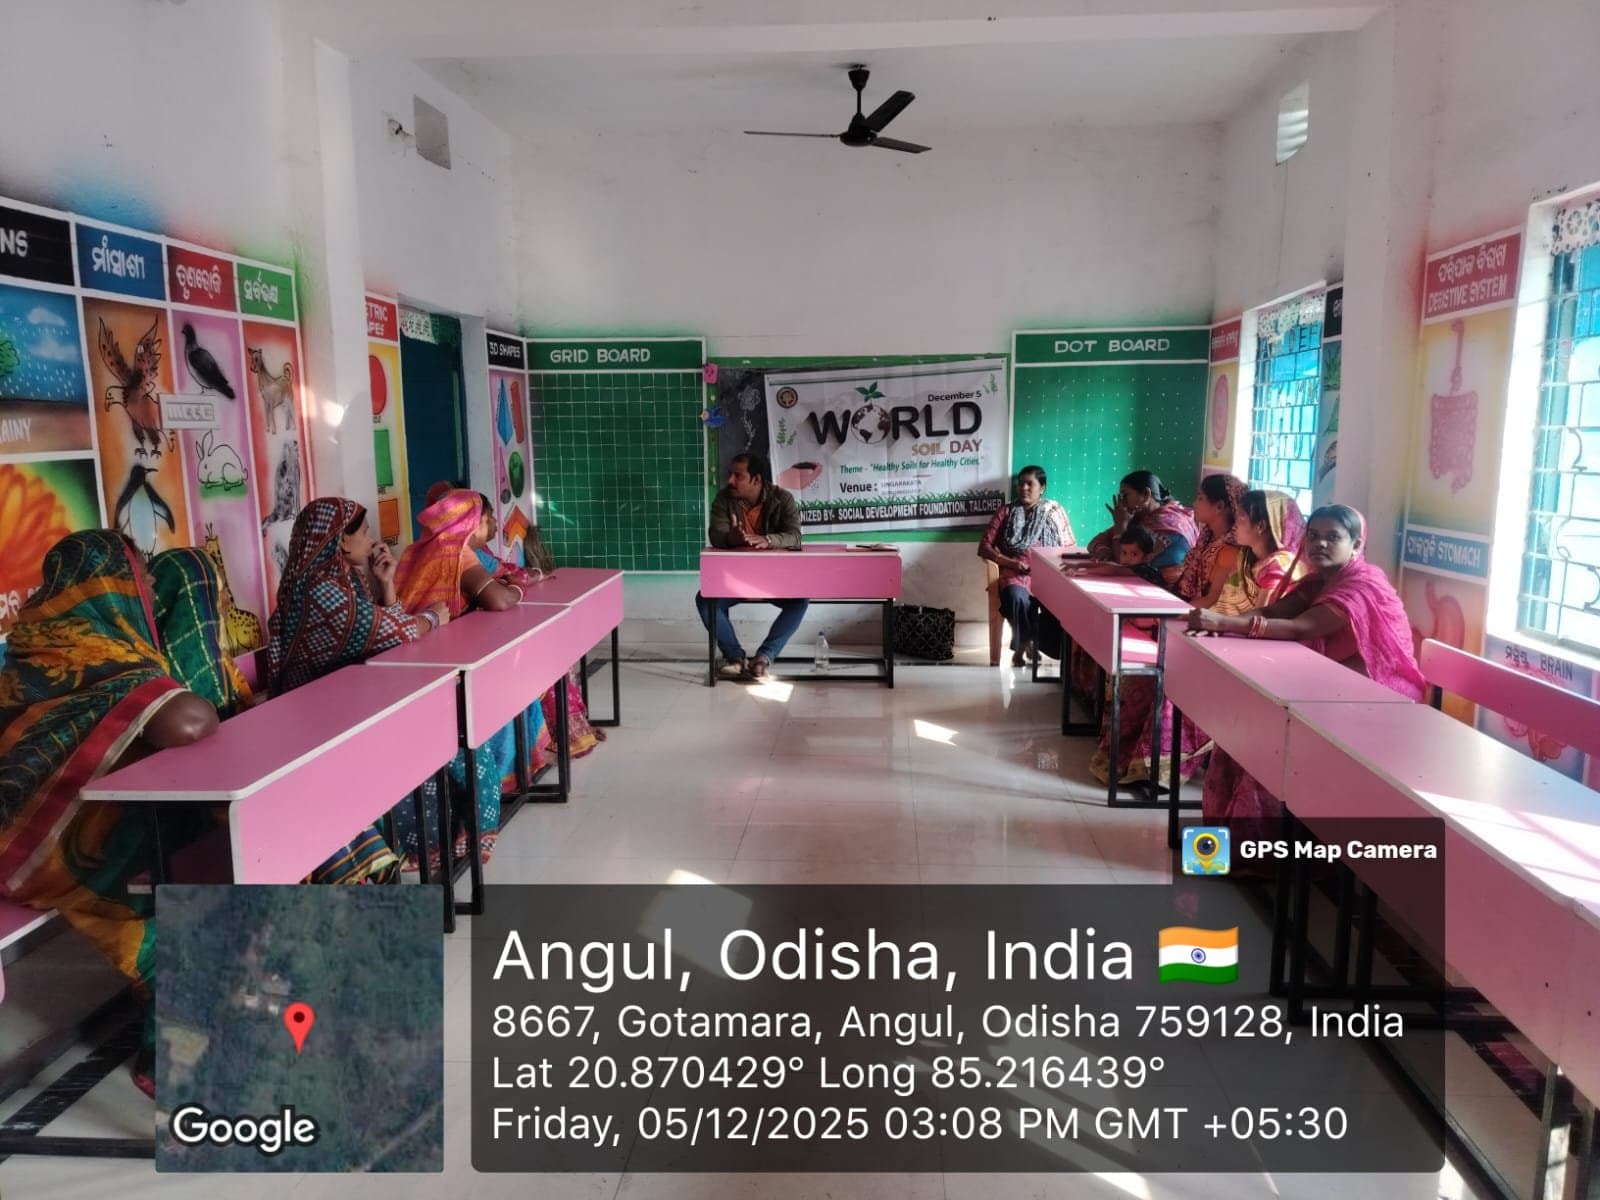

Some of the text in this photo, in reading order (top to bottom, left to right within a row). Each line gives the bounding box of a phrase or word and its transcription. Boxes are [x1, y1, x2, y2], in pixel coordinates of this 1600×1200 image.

[1055, 338, 1170, 353] DOT BOARD
[550, 348, 651, 363] GRID BOARD
[927, 390, 982, 402] December 5
[911, 439, 983, 456] SOIL DAY
[840, 464, 863, 474] Theme
[918, 459, 930, 469] for
[931, 457, 957, 469] Healthy
[840, 482, 872, 493] Venue
[838, 507, 865, 520] SOCIAL
[865, 503, 917, 519] DEVELOPMENT
[1437, 541, 1481, 569] STOMACH
[1540, 653, 1573, 681] BRAIN
